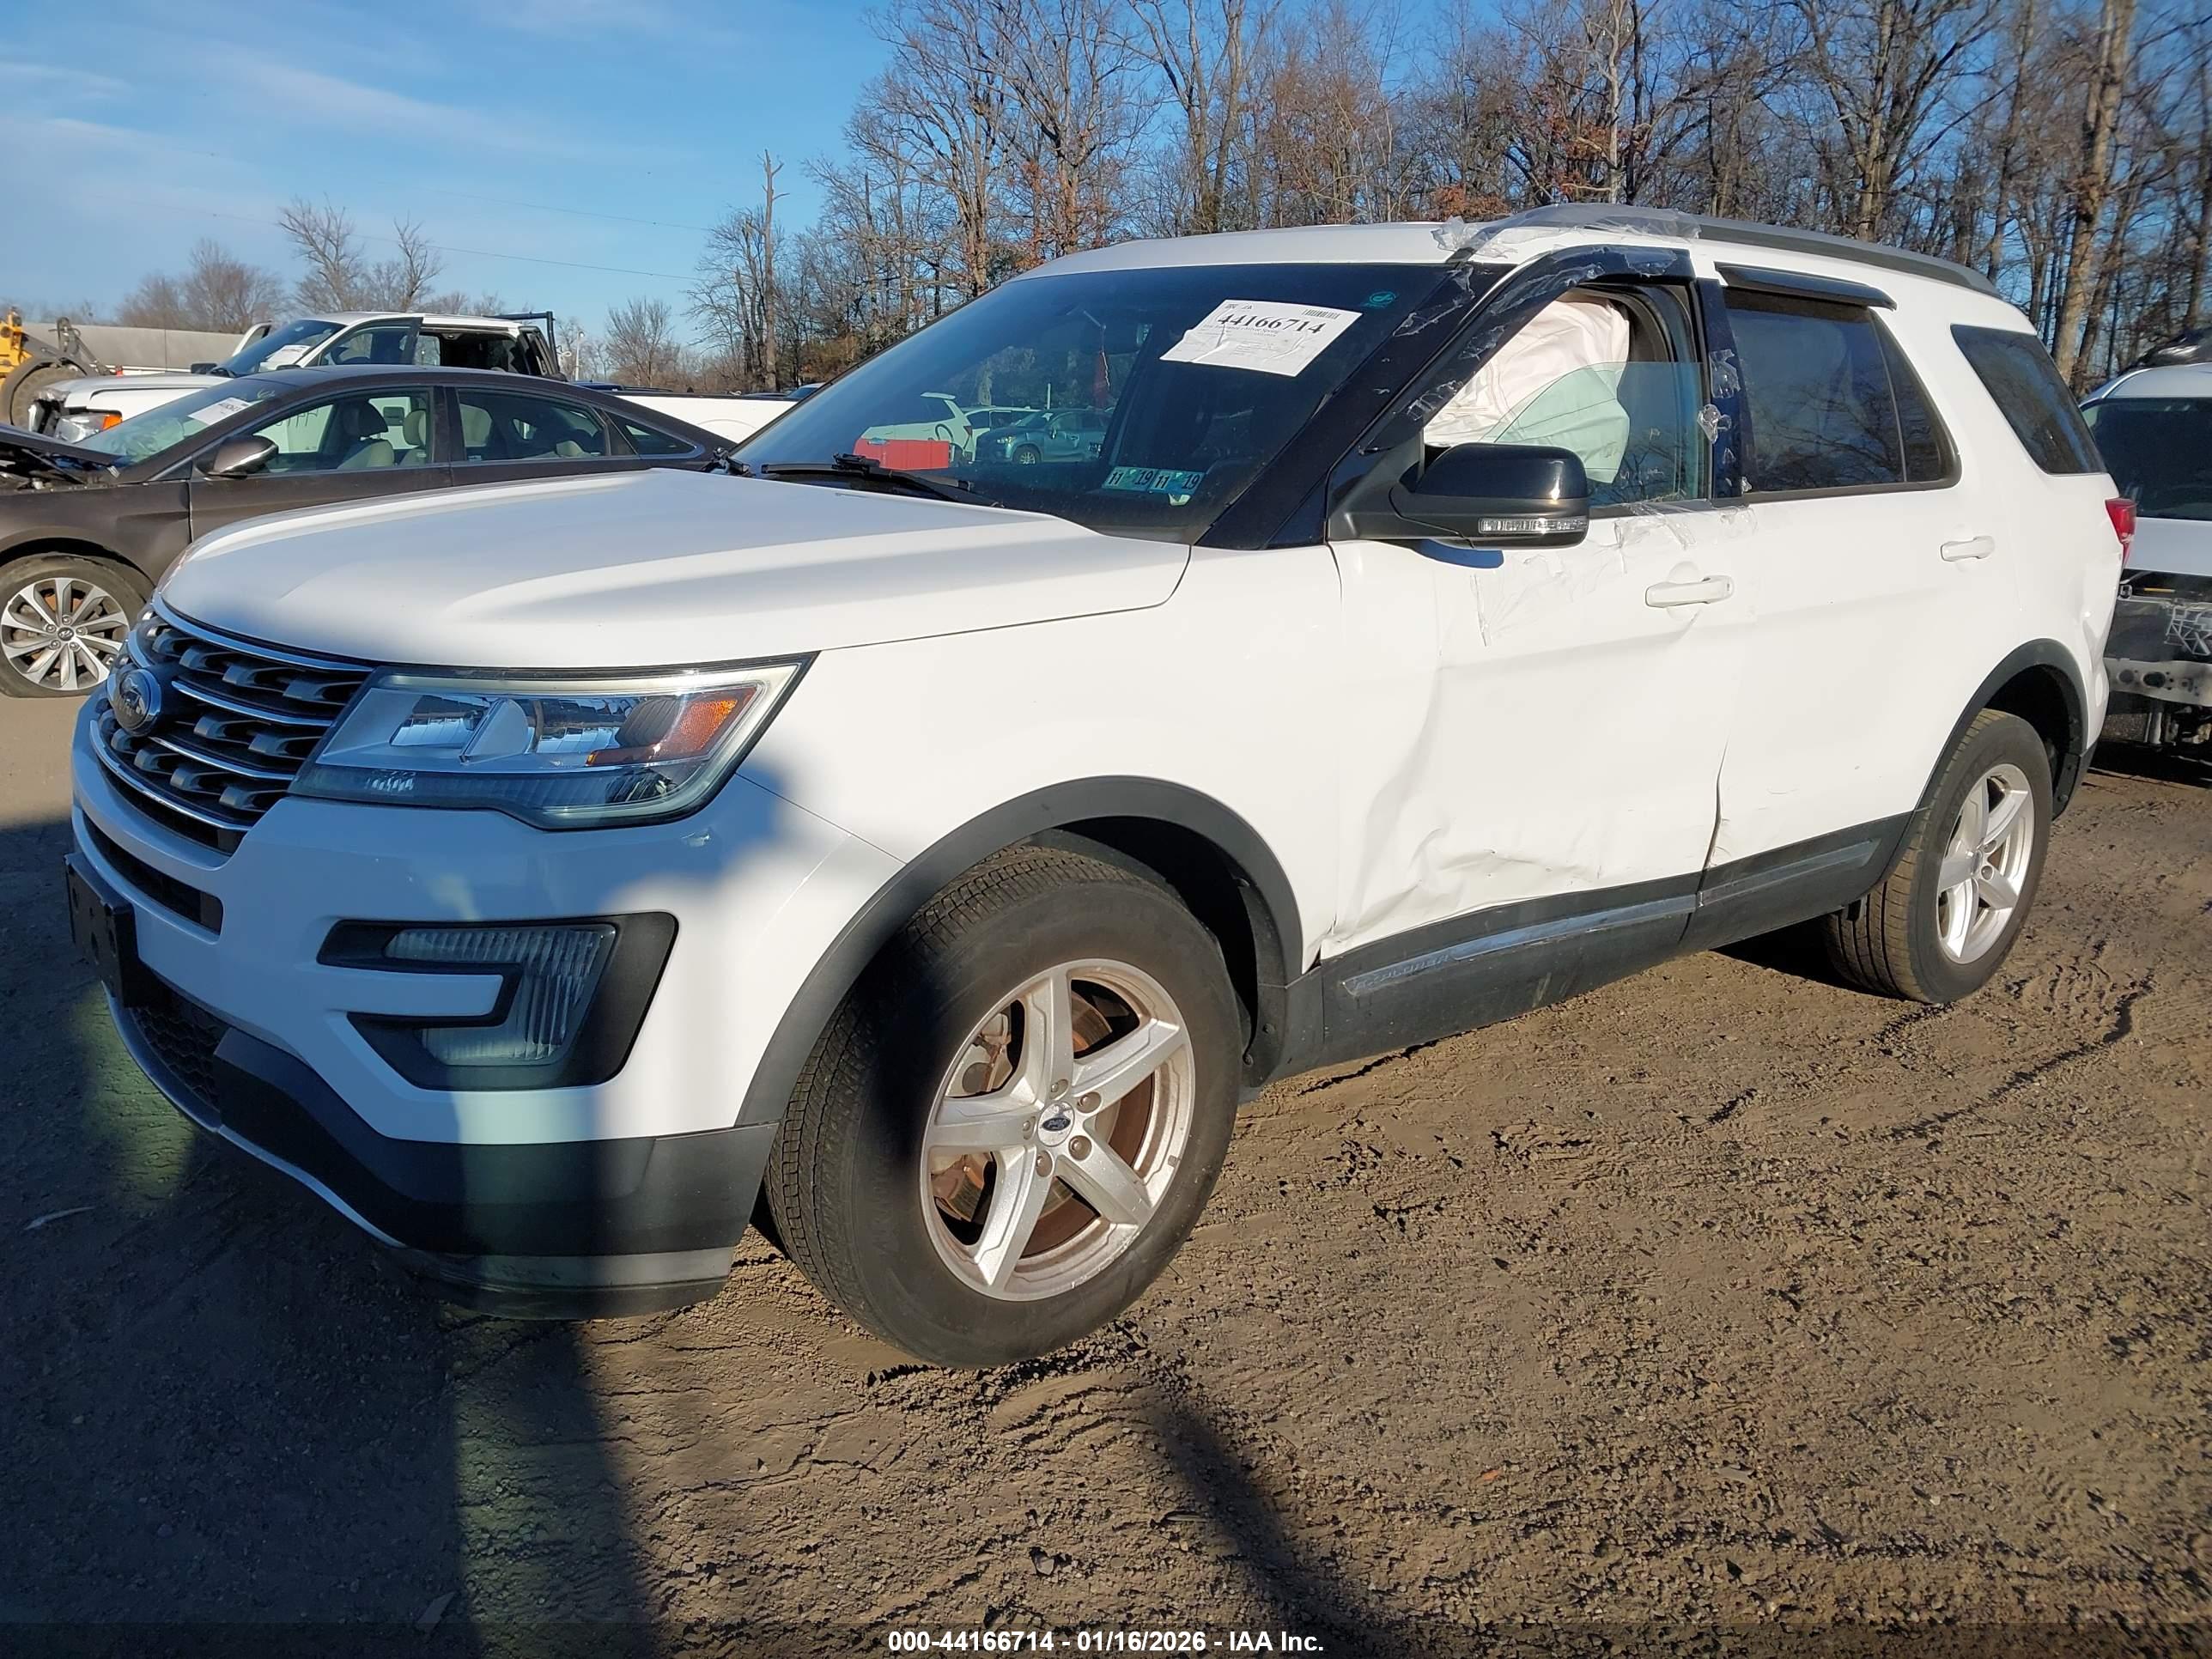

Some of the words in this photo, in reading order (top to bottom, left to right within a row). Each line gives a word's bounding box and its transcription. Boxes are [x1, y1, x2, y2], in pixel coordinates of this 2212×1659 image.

[1217, 313, 1327, 334] 44166714
[1108, 472, 1124, 485] 11
[1134, 471, 1154, 486] 19
[1155, 475, 1170, 489] 11
[1181, 473, 1200, 489] 19
